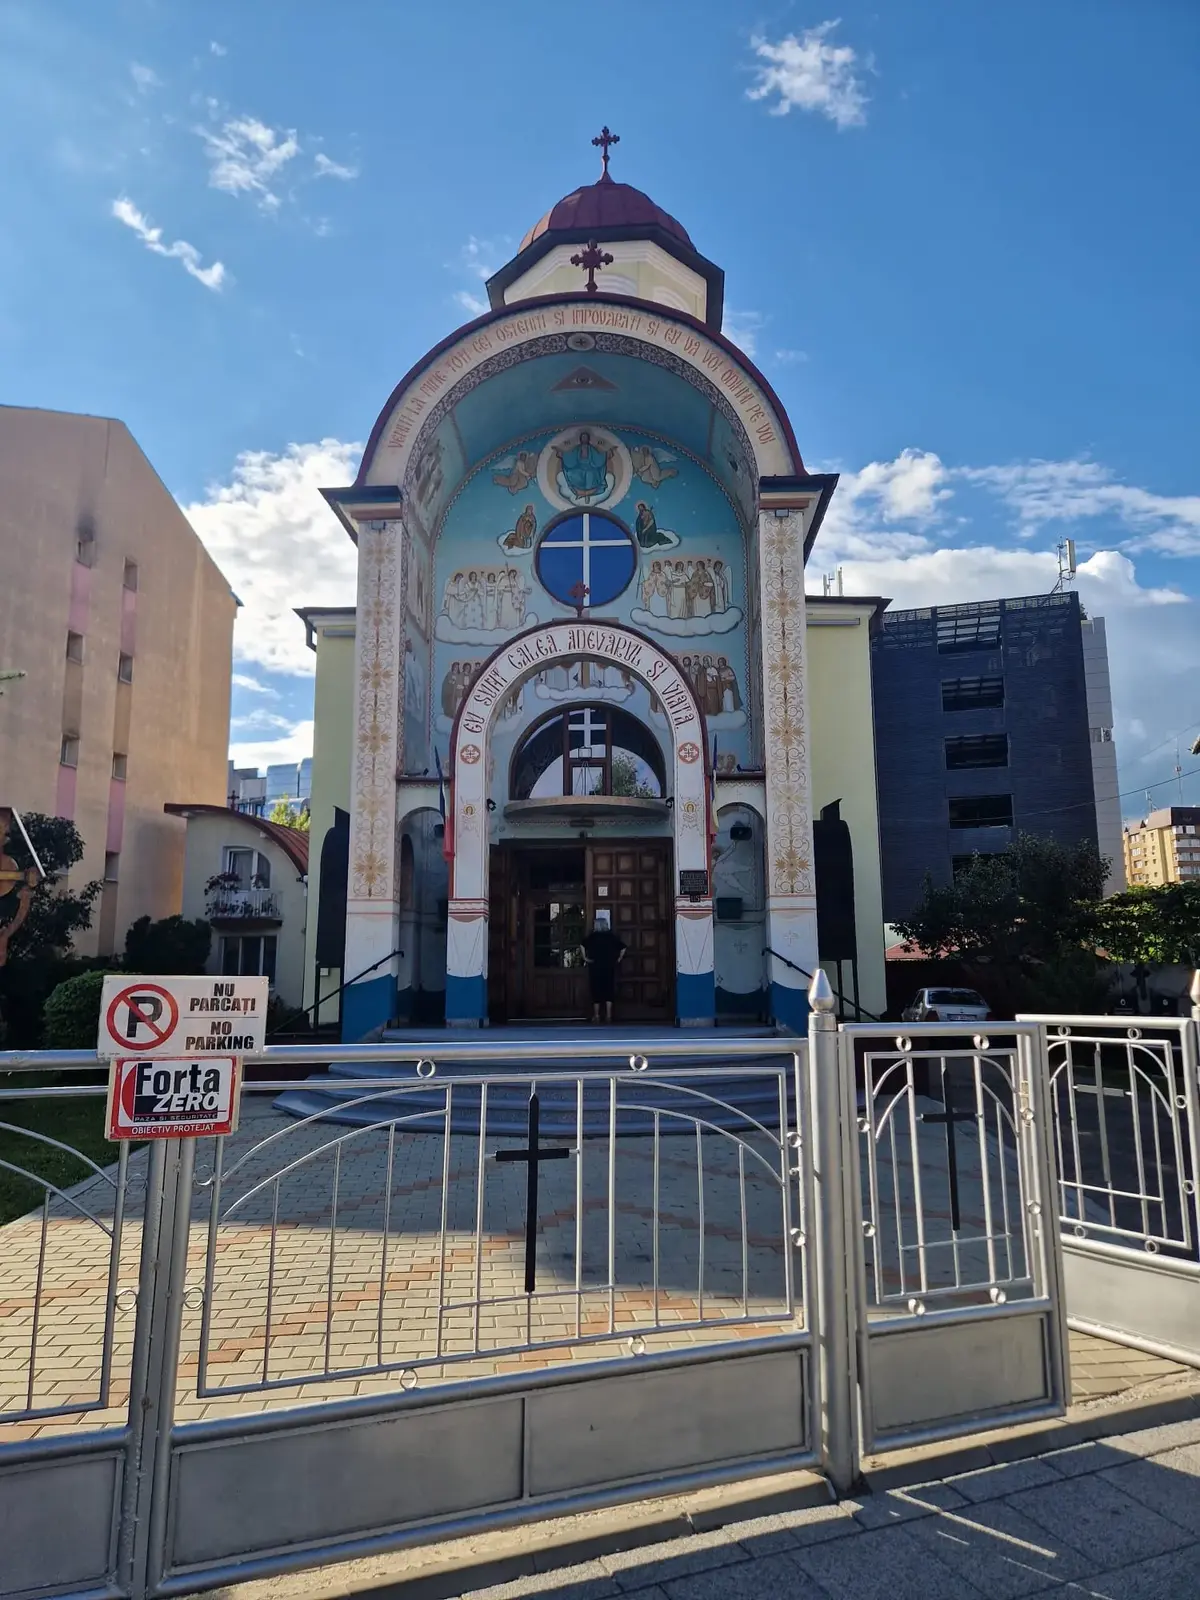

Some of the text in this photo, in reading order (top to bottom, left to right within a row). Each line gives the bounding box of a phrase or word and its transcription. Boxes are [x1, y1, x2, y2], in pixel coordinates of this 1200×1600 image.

[405, 397, 426, 415] LA
[472, 335, 493, 353] CEI
[664, 327, 682, 345] EU
[702, 348, 724, 372] VOI
[745, 403, 764, 423] PE
[756, 422, 776, 445] VOI
[462, 711, 486, 734] EU
[474, 667, 508, 707] SUNT
[568, 628, 644, 667] ADEVARUL
[213, 983, 235, 997] NU
[189, 997, 256, 1016] PARCAȚI
[210, 1021, 232, 1035] NO
[185, 1036, 255, 1051] PARKING
[152, 1091, 220, 1113] ZERO
[170, 1113, 217, 1121] SECURITATE
[131, 1123, 215, 1135] OBIECTIV PROTEJAT
